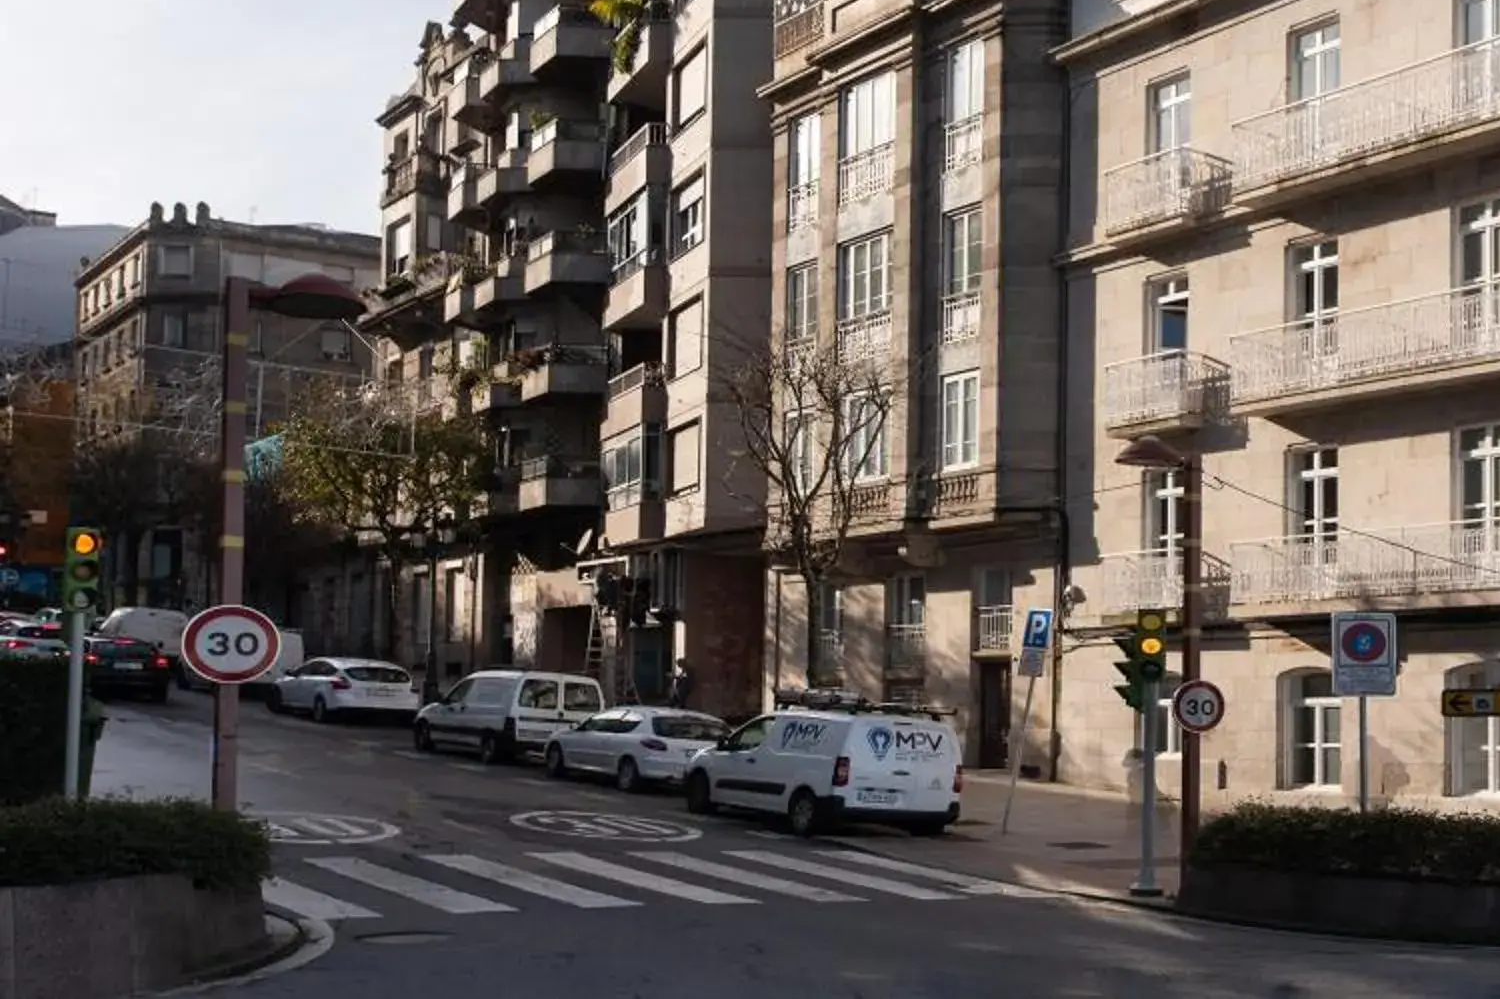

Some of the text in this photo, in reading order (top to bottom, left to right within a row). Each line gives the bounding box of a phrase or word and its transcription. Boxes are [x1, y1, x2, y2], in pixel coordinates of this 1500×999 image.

[1029, 613, 1047, 643] P
[207, 632, 259, 655] 30
[1186, 699, 1215, 715] 30
[796, 723, 827, 739] MPV
[895, 733, 943, 751] MPV
